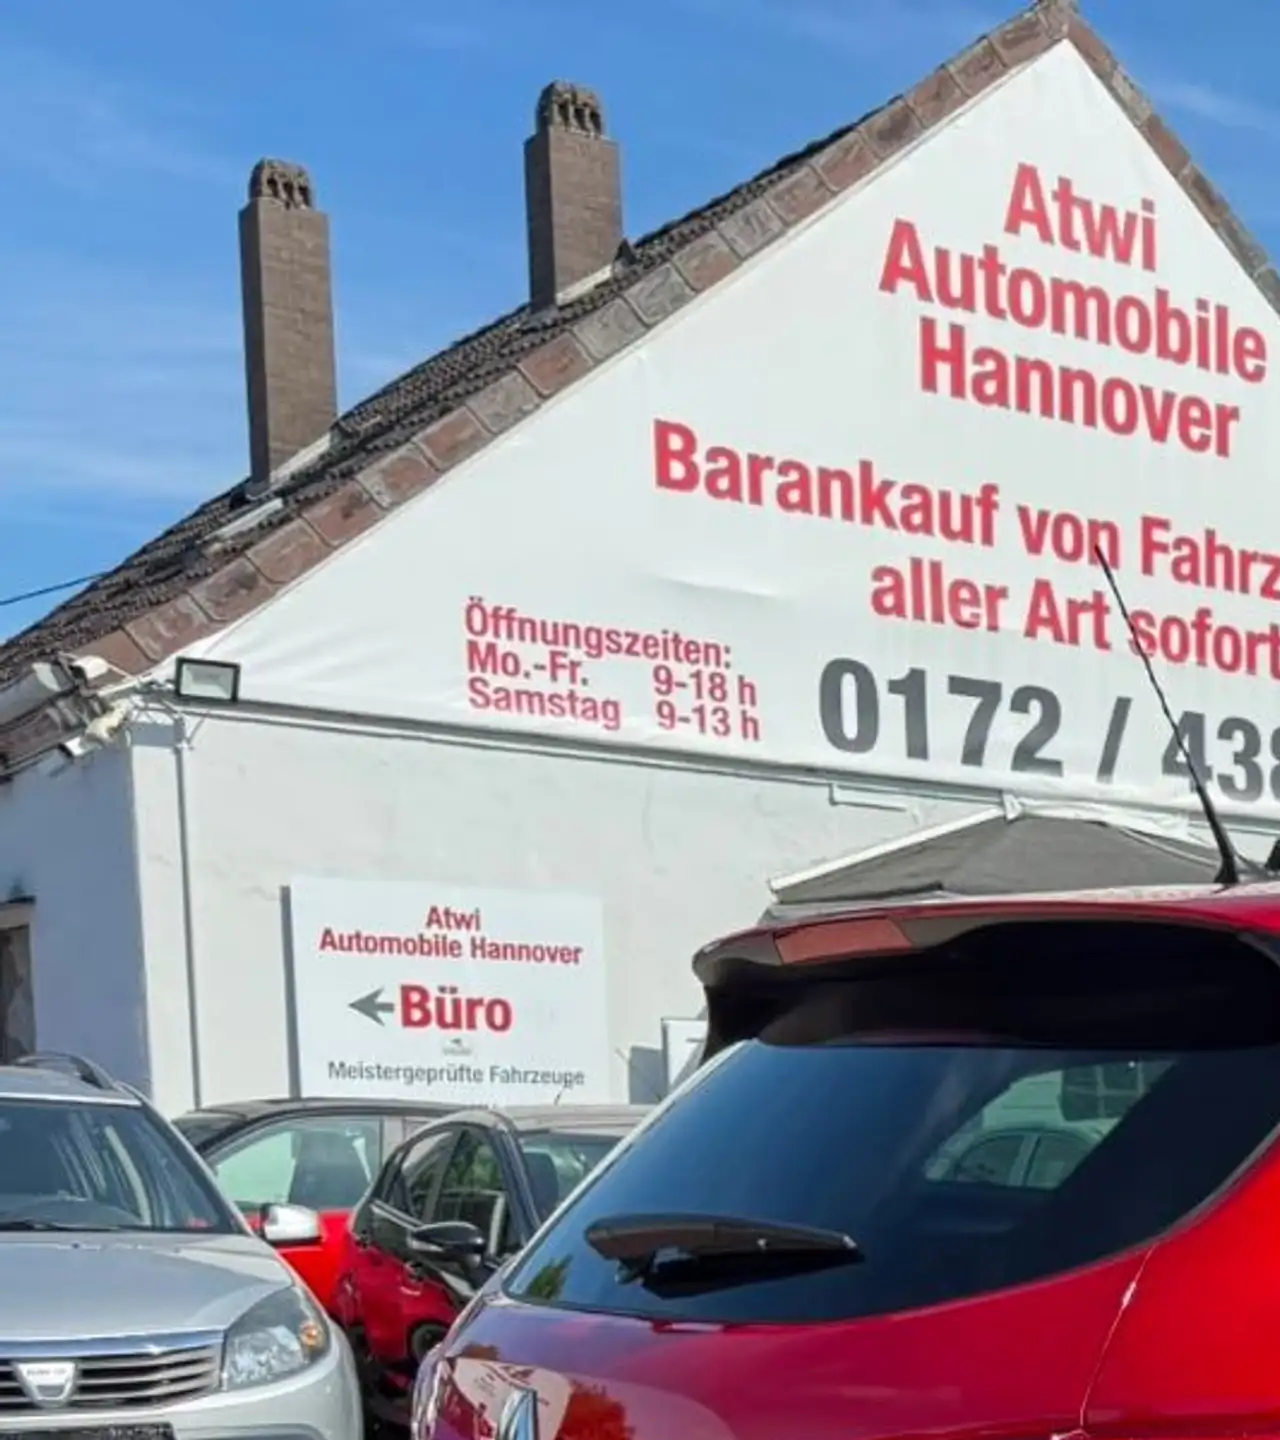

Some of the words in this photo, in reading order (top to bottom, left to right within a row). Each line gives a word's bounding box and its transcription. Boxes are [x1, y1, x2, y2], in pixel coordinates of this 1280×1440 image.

[1004, 162, 1156, 272] Atwi
[879, 218, 1267, 383] Automobile
[919, 315, 1240, 457] Hannover
[654, 419, 999, 546] Barankauf
[1016, 504, 1119, 570] von
[465, 596, 732, 669] Öffnungszeiten:
[871, 557, 1008, 632] aller
[1024, 578, 1111, 651] Art
[466, 640, 588, 686] Mo.-Fr.
[653, 665, 728, 702] 9-18
[737, 675, 757, 706] h
[468, 677, 621, 731] Samstag
[656, 700, 731, 737] 9-13
[741, 710, 760, 740] h
[819, 657, 1063, 777] 0172
[319, 927, 462, 959] Automobile
[470, 937, 583, 964] Hannover
[425, 905, 481, 931] Atwi
[400, 984, 512, 1032] Büro
[328, 1060, 483, 1086] Meistergeprüfte
[490, 1065, 584, 1089] Fahrzeuge
